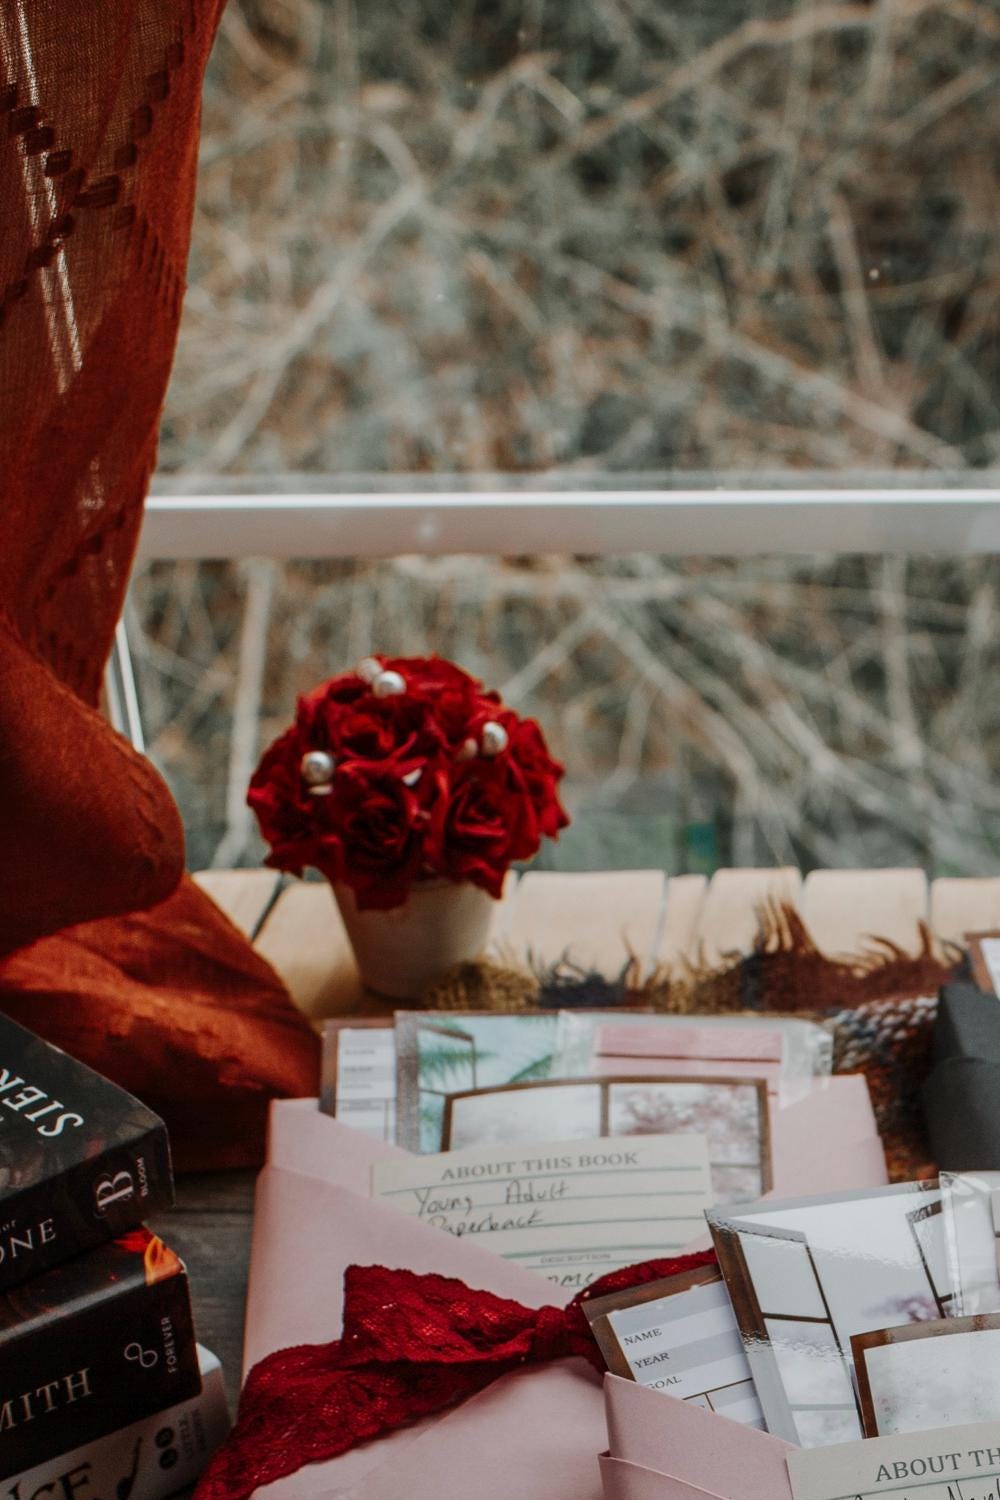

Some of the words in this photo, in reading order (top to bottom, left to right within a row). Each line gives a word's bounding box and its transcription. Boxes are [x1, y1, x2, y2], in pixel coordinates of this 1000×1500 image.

[441, 1161, 517, 1181] ABOUT
[522, 1156, 573, 1171] THIS
[579, 1152, 639, 1168] BOOK
[414, 1188, 472, 1217] Young
[506, 1179, 569, 1205] Adult
[160, 1316, 178, 1374] FOREVER
[624, 1328, 662, 1345] NAME
[634, 1352, 670, 1369] YEAR
[875, 1453, 962, 1482] ABOUT
